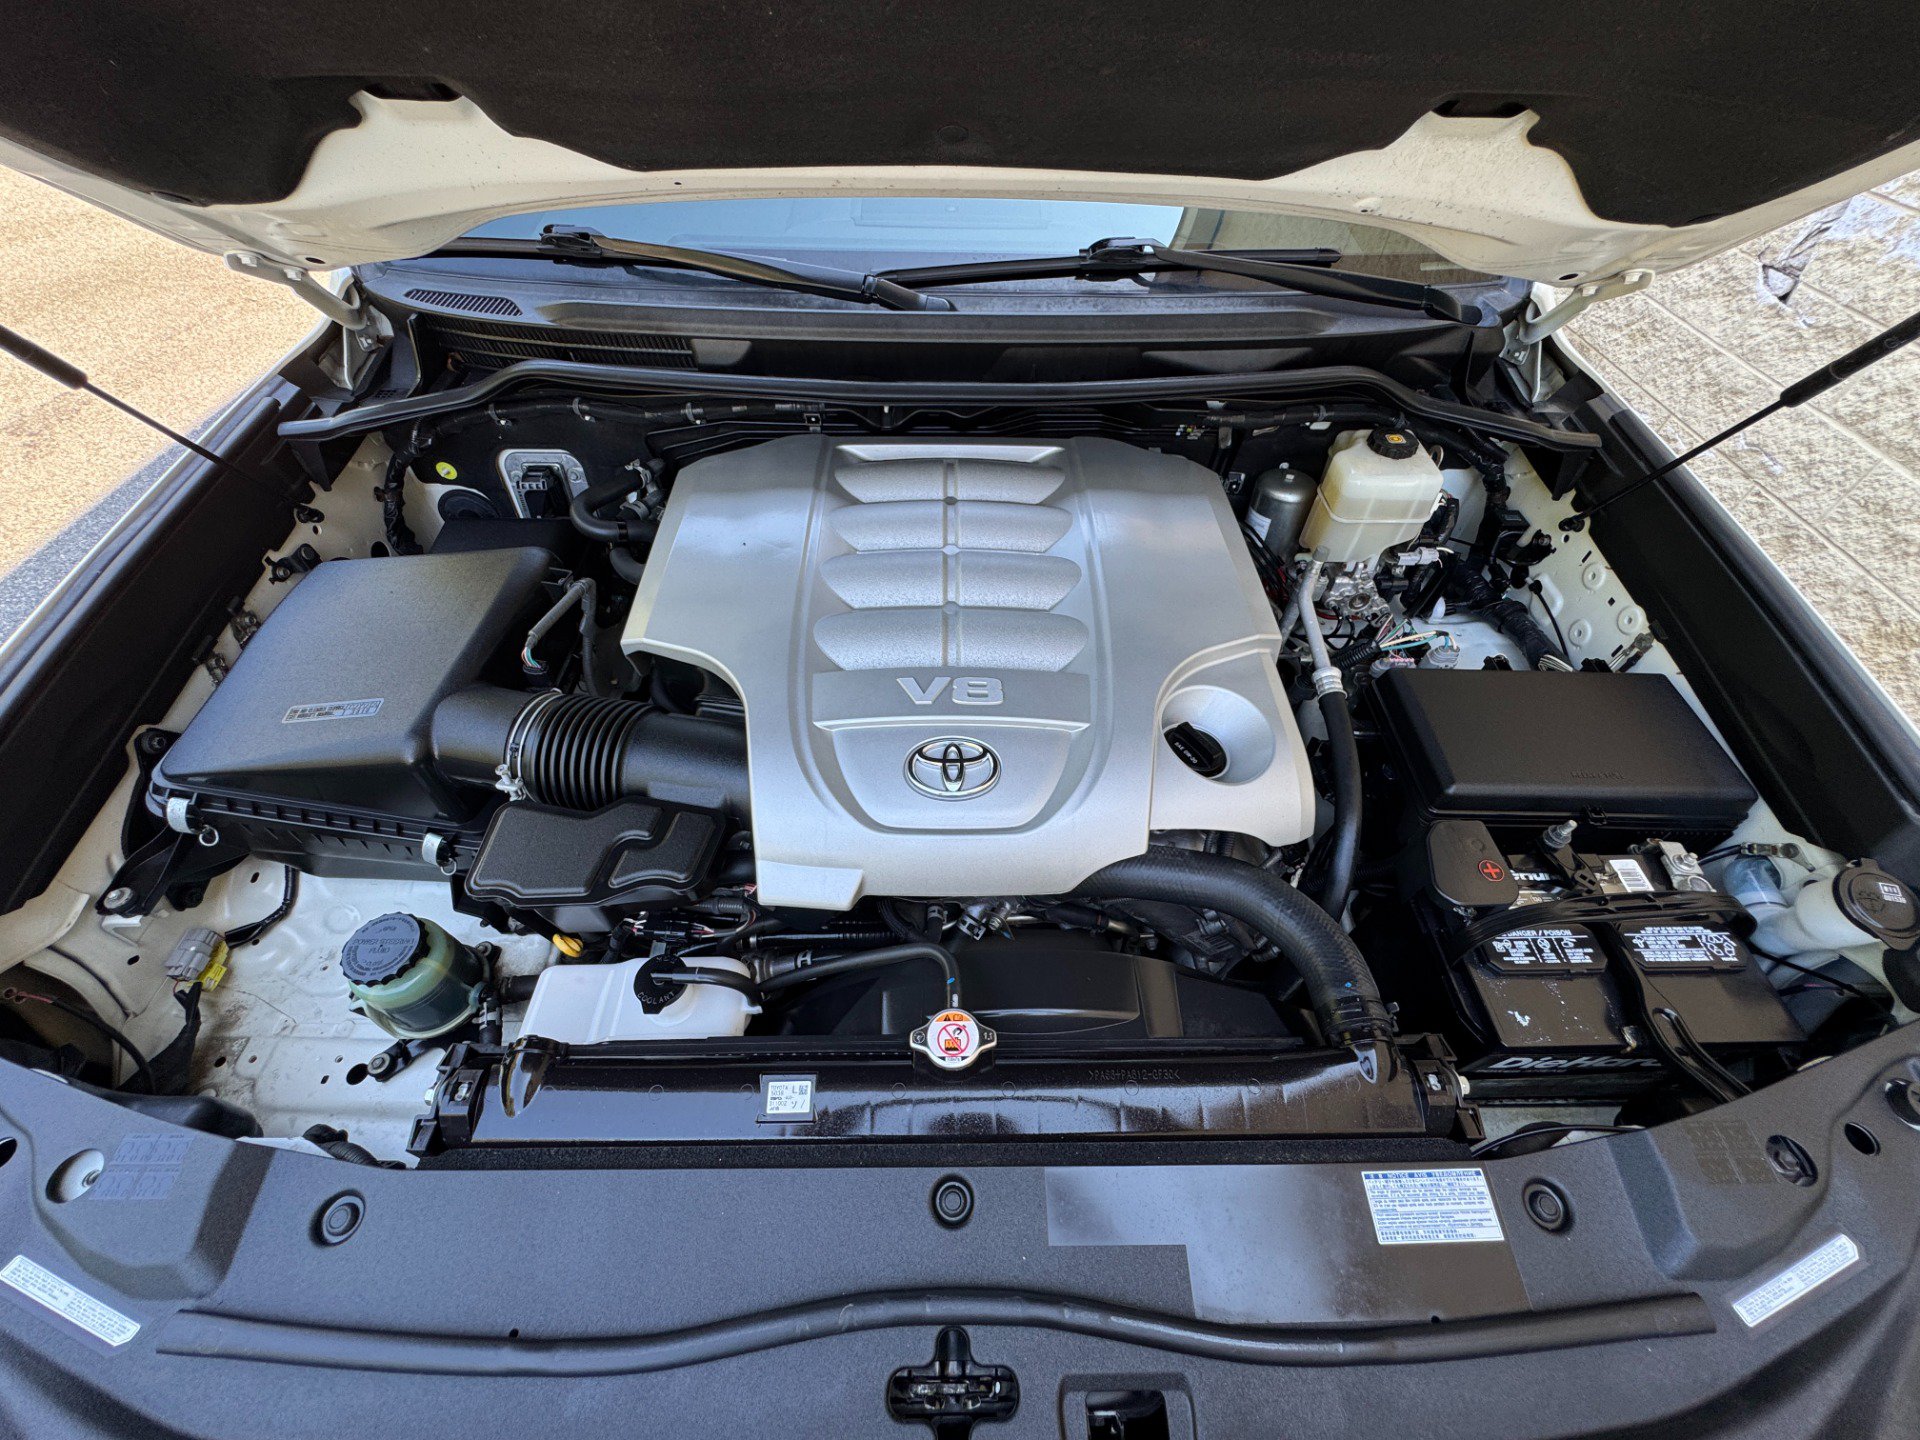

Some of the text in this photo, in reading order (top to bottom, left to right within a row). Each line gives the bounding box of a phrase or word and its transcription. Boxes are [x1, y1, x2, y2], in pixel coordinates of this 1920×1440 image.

[896, 676, 1004, 706] V8
[1174, 741, 1185, 751] SAE
[637, 991, 676, 1005] COOLANT
